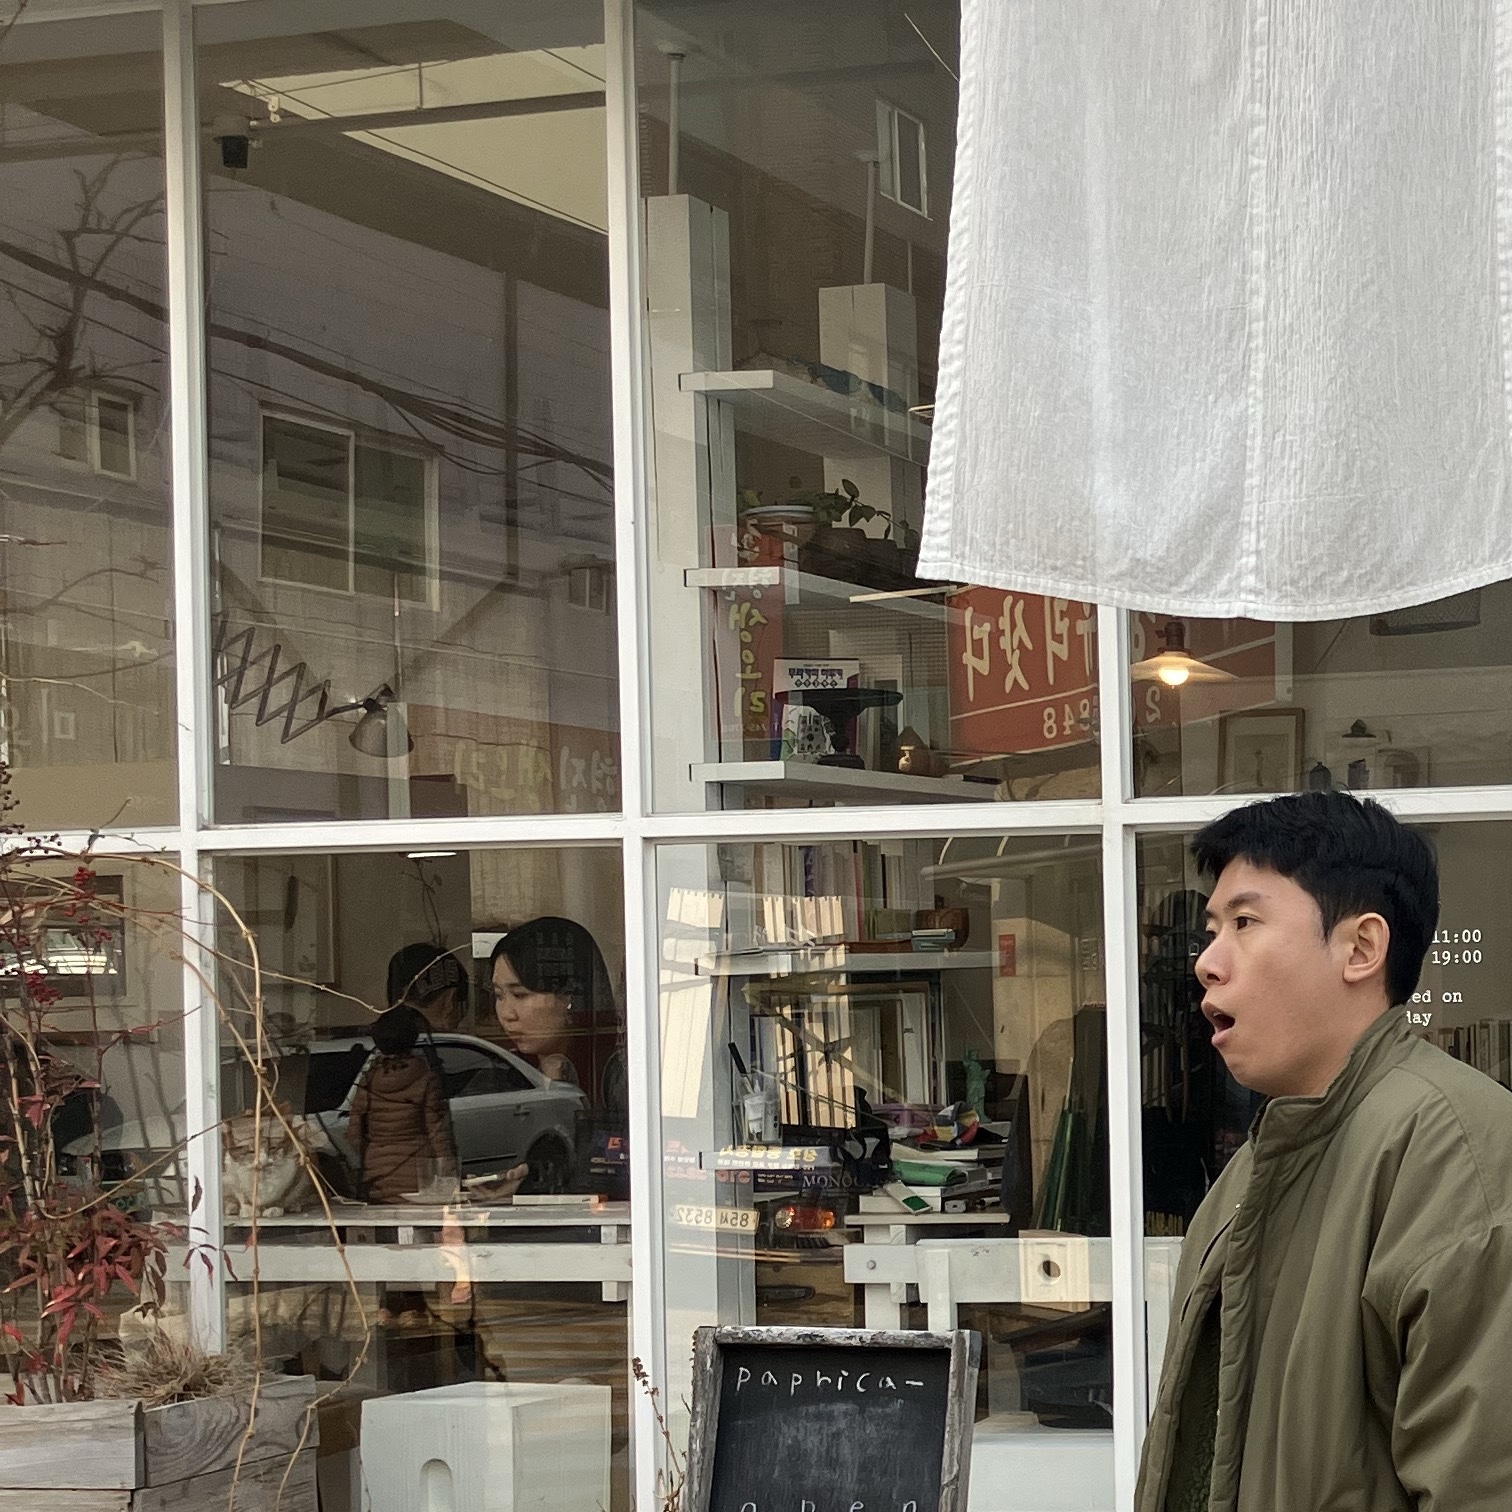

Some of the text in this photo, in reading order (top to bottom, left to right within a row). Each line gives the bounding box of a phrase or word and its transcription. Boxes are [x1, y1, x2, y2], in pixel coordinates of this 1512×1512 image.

[1431, 929, 1482, 943] 11:00
[1431, 949, 1482, 965] 19:00
[1408, 989, 1463, 1003] ed on
